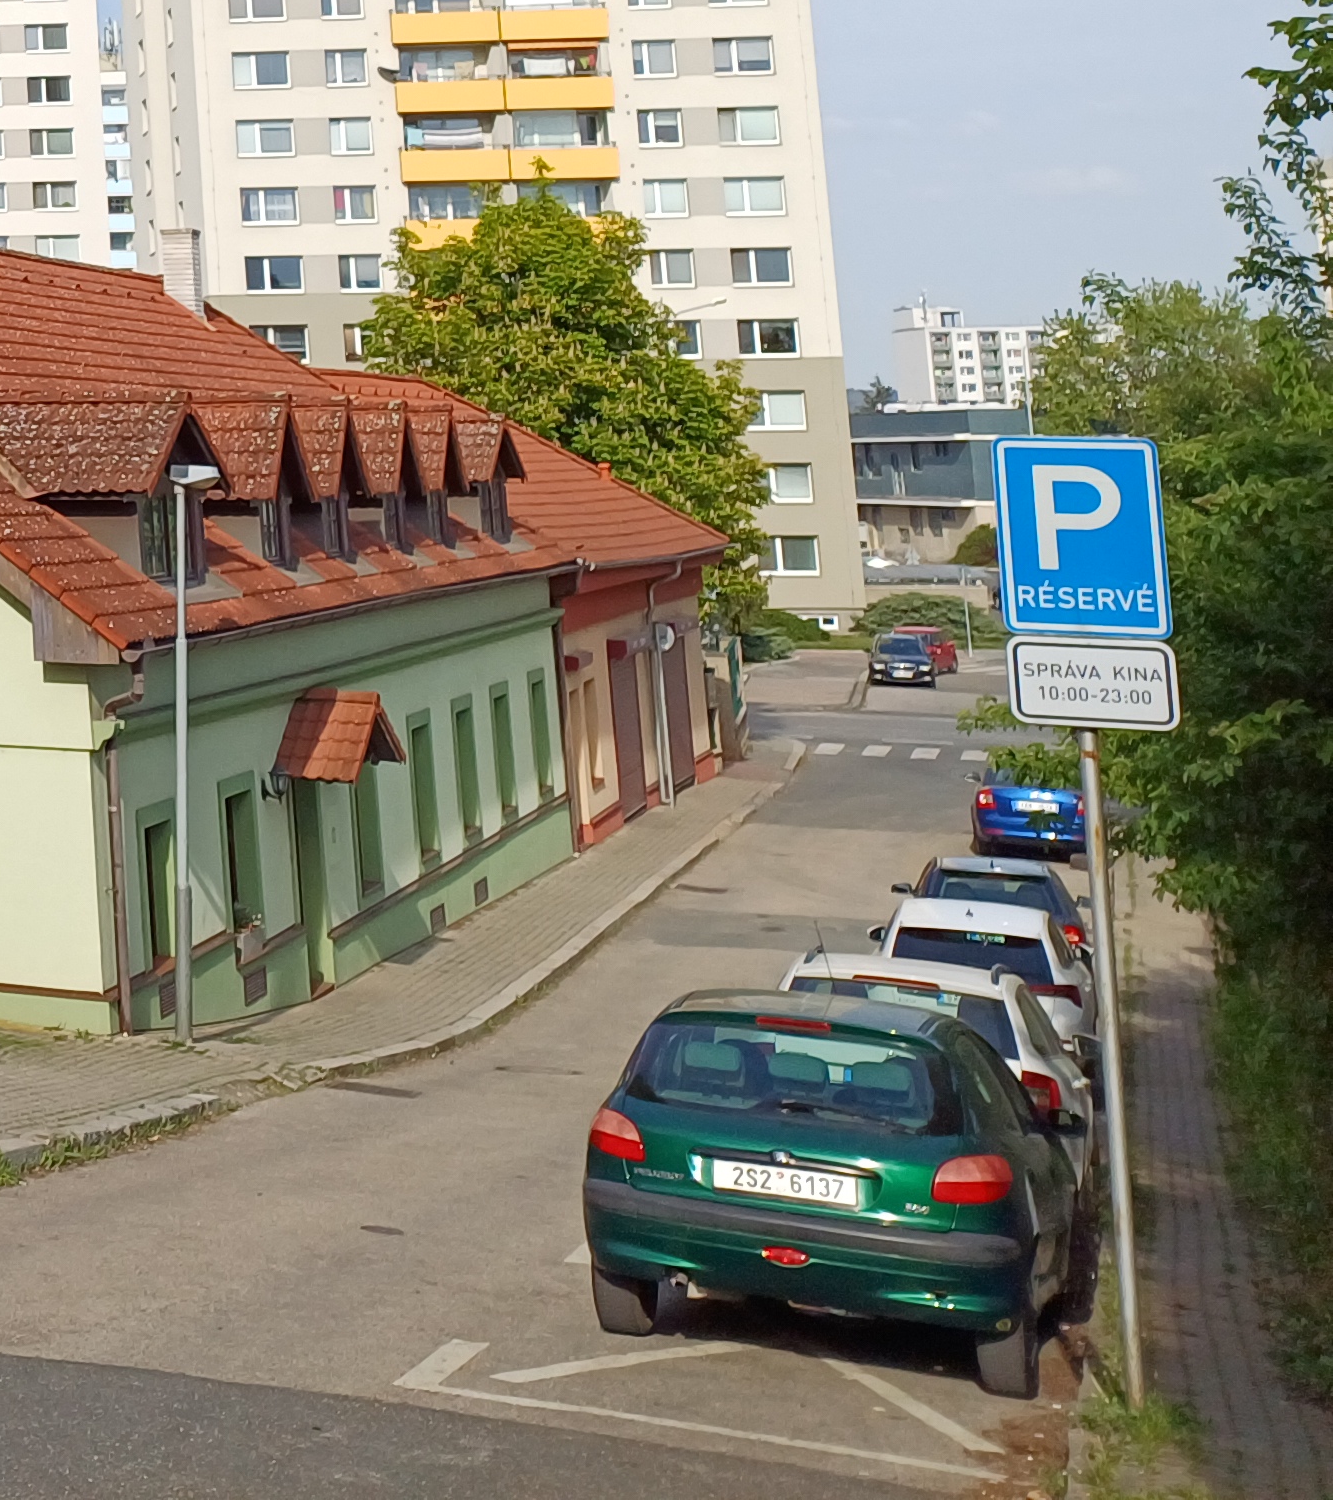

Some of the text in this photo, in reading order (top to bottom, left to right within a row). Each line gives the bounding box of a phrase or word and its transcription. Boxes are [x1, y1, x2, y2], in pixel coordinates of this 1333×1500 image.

[1032, 464, 1121, 571] P
[1018, 580, 1155, 613] RÉSERVÉ
[1023, 660, 1163, 683] SPRÁVA KINA
[1038, 685, 1153, 706] 10:00-23:00
[732, 1166, 844, 1200] 2S2 6137
